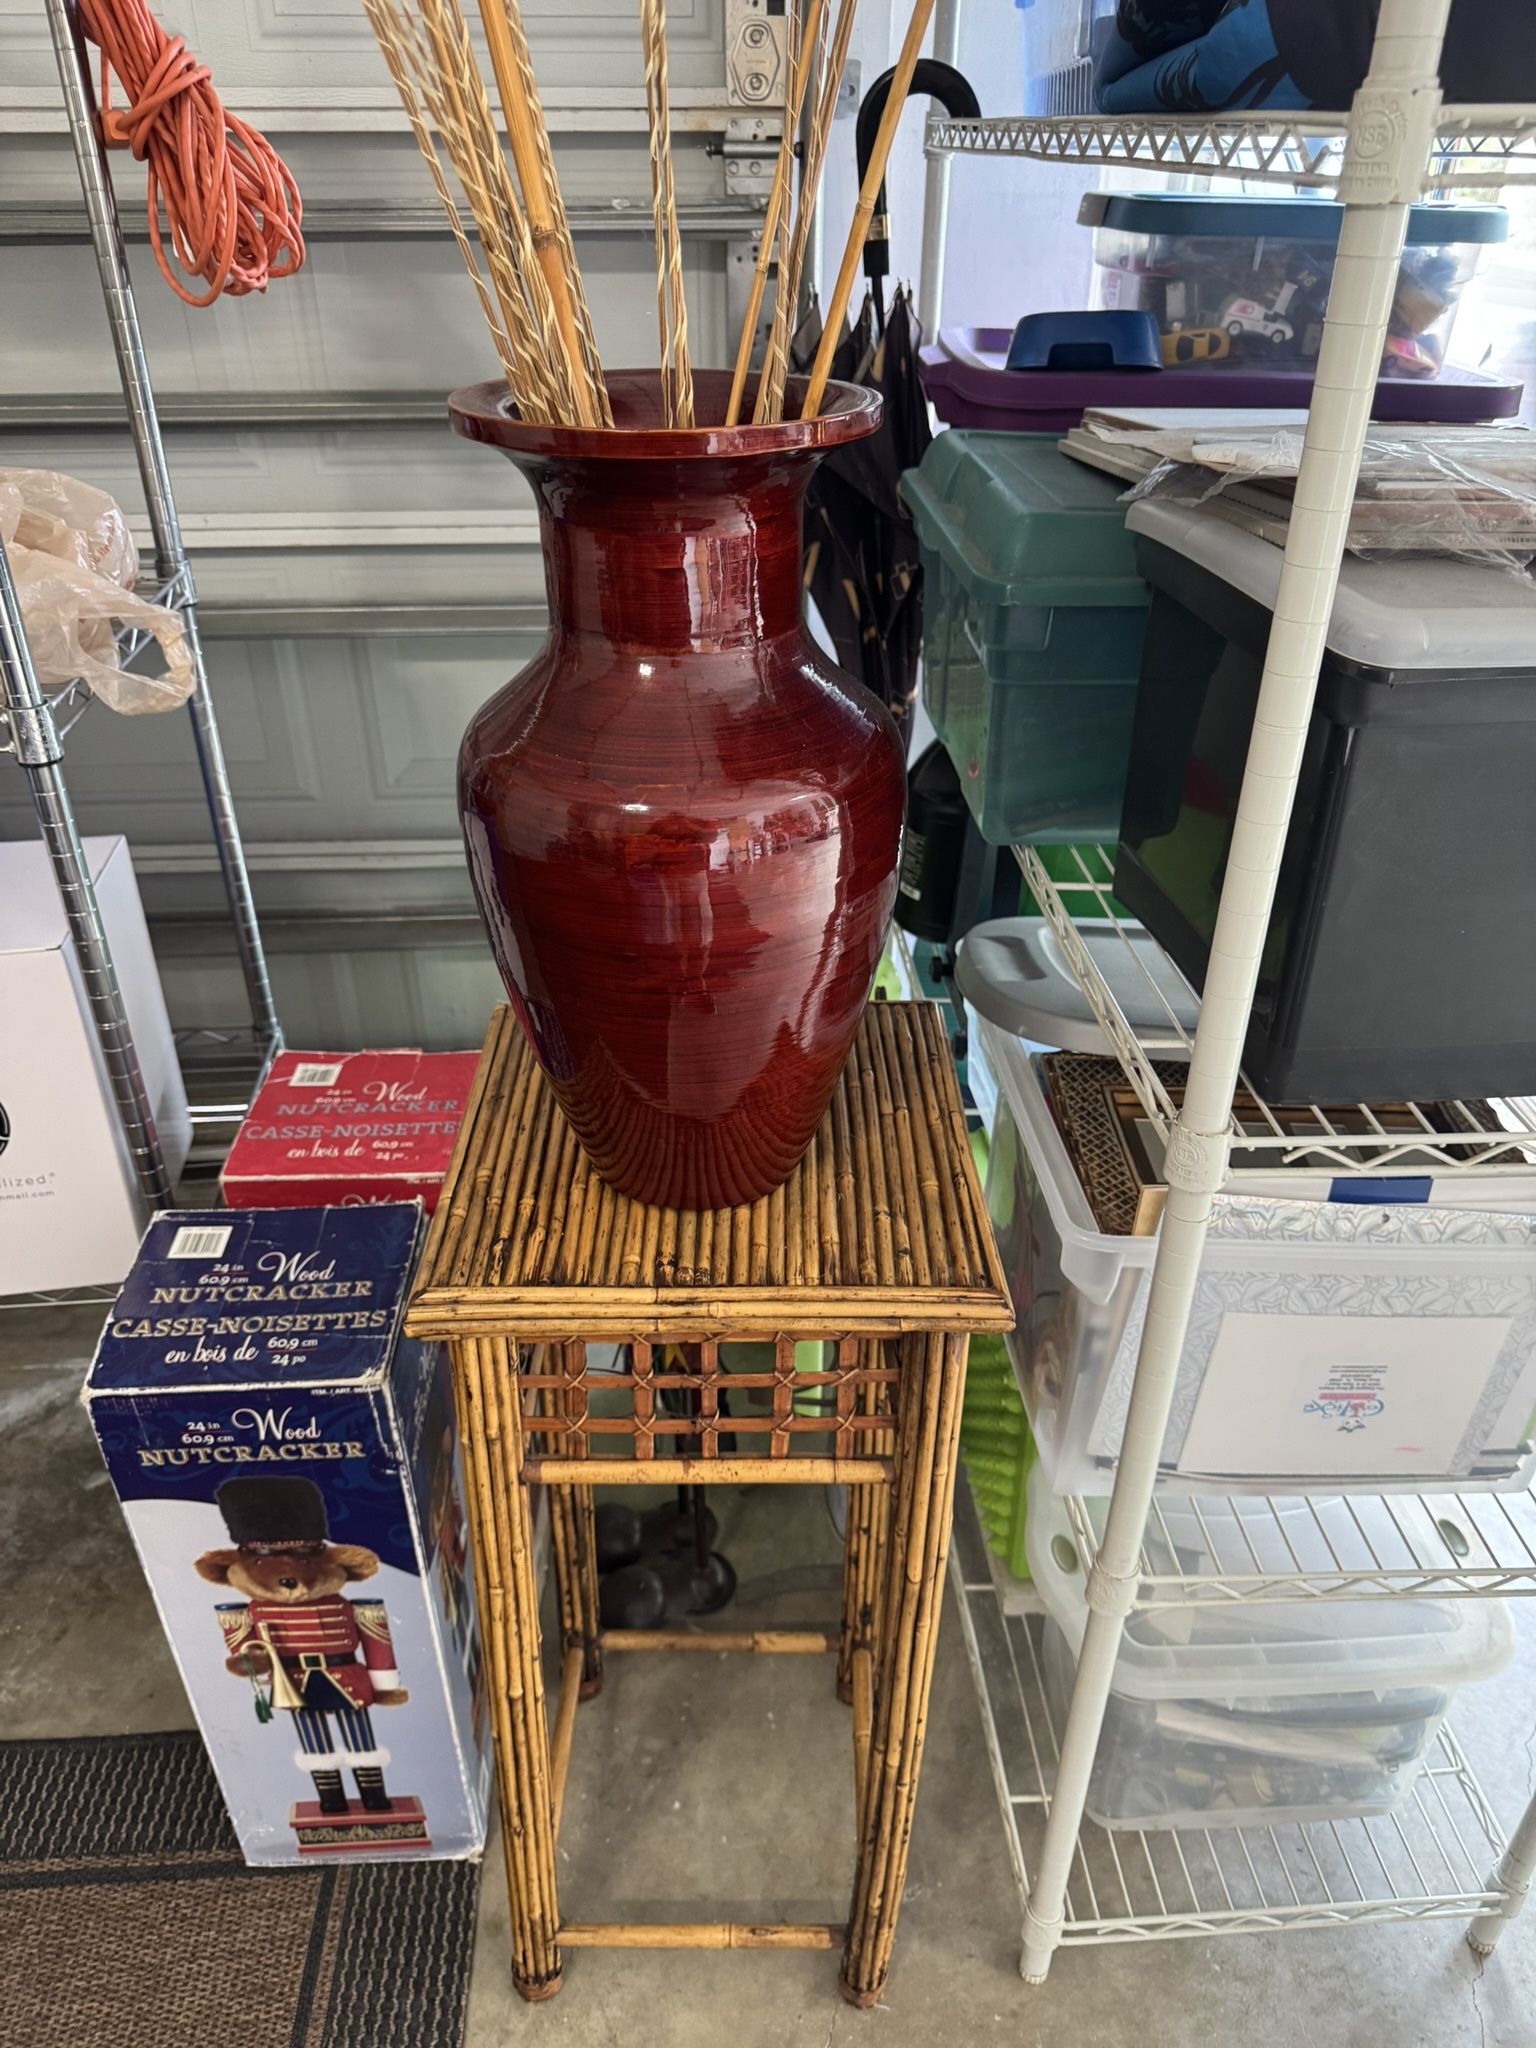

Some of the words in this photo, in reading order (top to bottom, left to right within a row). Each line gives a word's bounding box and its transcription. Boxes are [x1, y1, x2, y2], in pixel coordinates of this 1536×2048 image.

[362, 1081, 428, 1103] Wood
[275, 1100, 458, 1117] NUTCRACKER
[287, 1148, 309, 1159] en
[344, 1138, 366, 1158] de
[212, 1263, 230, 1273] 24
[231, 1263, 244, 1272] in
[256, 1250, 336, 1283] Wood
[231, 1275, 249, 1285] cm
[150, 1280, 374, 1304] NUTCRACKER
[112, 1310, 387, 1338] CASSE-NOISETTES
[164, 1349, 191, 1364] en
[192, 1336, 227, 1363] bois
[233, 1335, 259, 1362] de
[301, 1338, 318, 1348] cm
[271, 1354, 289, 1366] 24
[292, 1355, 306, 1364] po
[187, 1421, 206, 1432] 24
[207, 1420, 221, 1430] in
[231, 1406, 322, 1441] Wood
[217, 1434, 235, 1443] cm
[137, 1441, 366, 1467] NUTCRACKER
